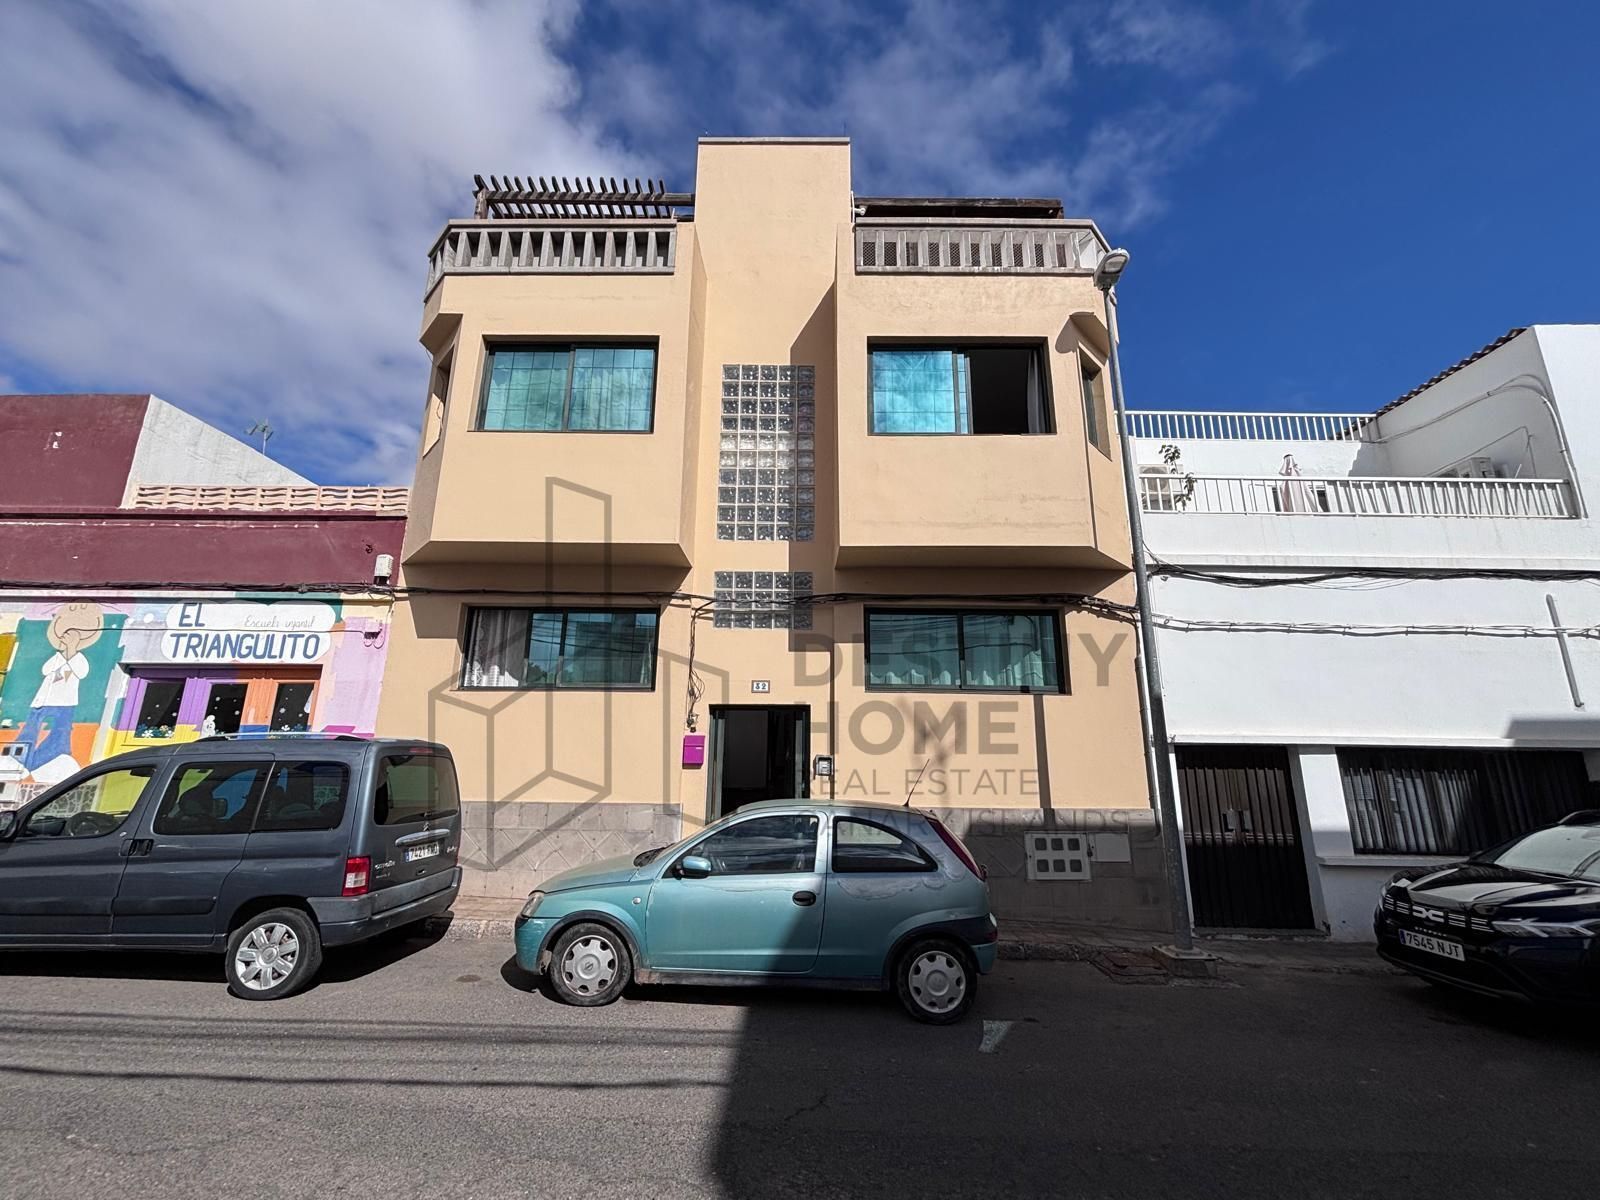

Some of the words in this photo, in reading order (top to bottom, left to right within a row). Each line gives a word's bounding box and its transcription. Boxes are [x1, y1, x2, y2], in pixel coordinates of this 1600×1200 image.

[179, 602, 206, 628] EL
[170, 632, 321, 660] TRIANGULITO
[1406, 933, 1434, 950] 7545
[1437, 941, 1459, 957] NJT
